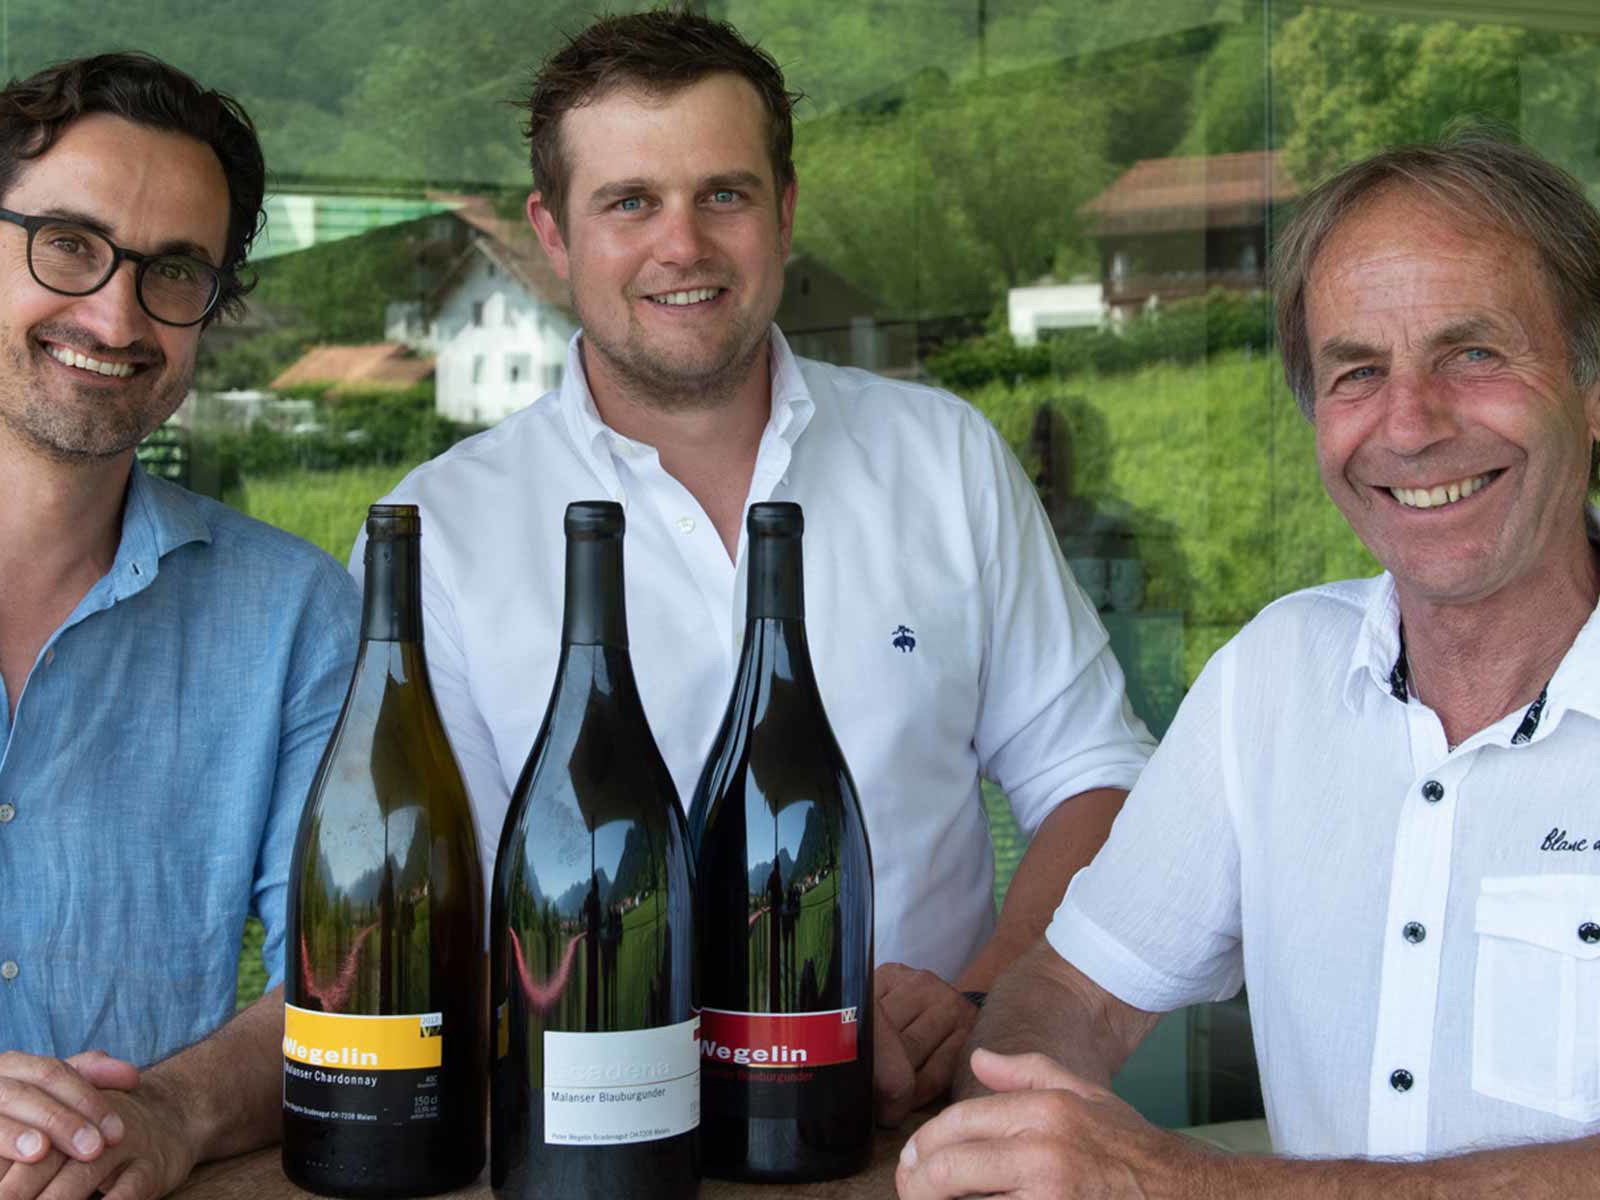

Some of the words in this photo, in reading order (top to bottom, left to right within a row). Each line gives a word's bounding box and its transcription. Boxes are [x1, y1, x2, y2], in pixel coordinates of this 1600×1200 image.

[1540, 827, 1588, 851] Blanc
[284, 1039, 378, 1066] Wegelin
[701, 1040, 808, 1064] Wegelin
[314, 1070, 378, 1087] Chardonnay
[551, 1091, 595, 1103] Malanser
[599, 1087, 666, 1103] Blauburgunder
